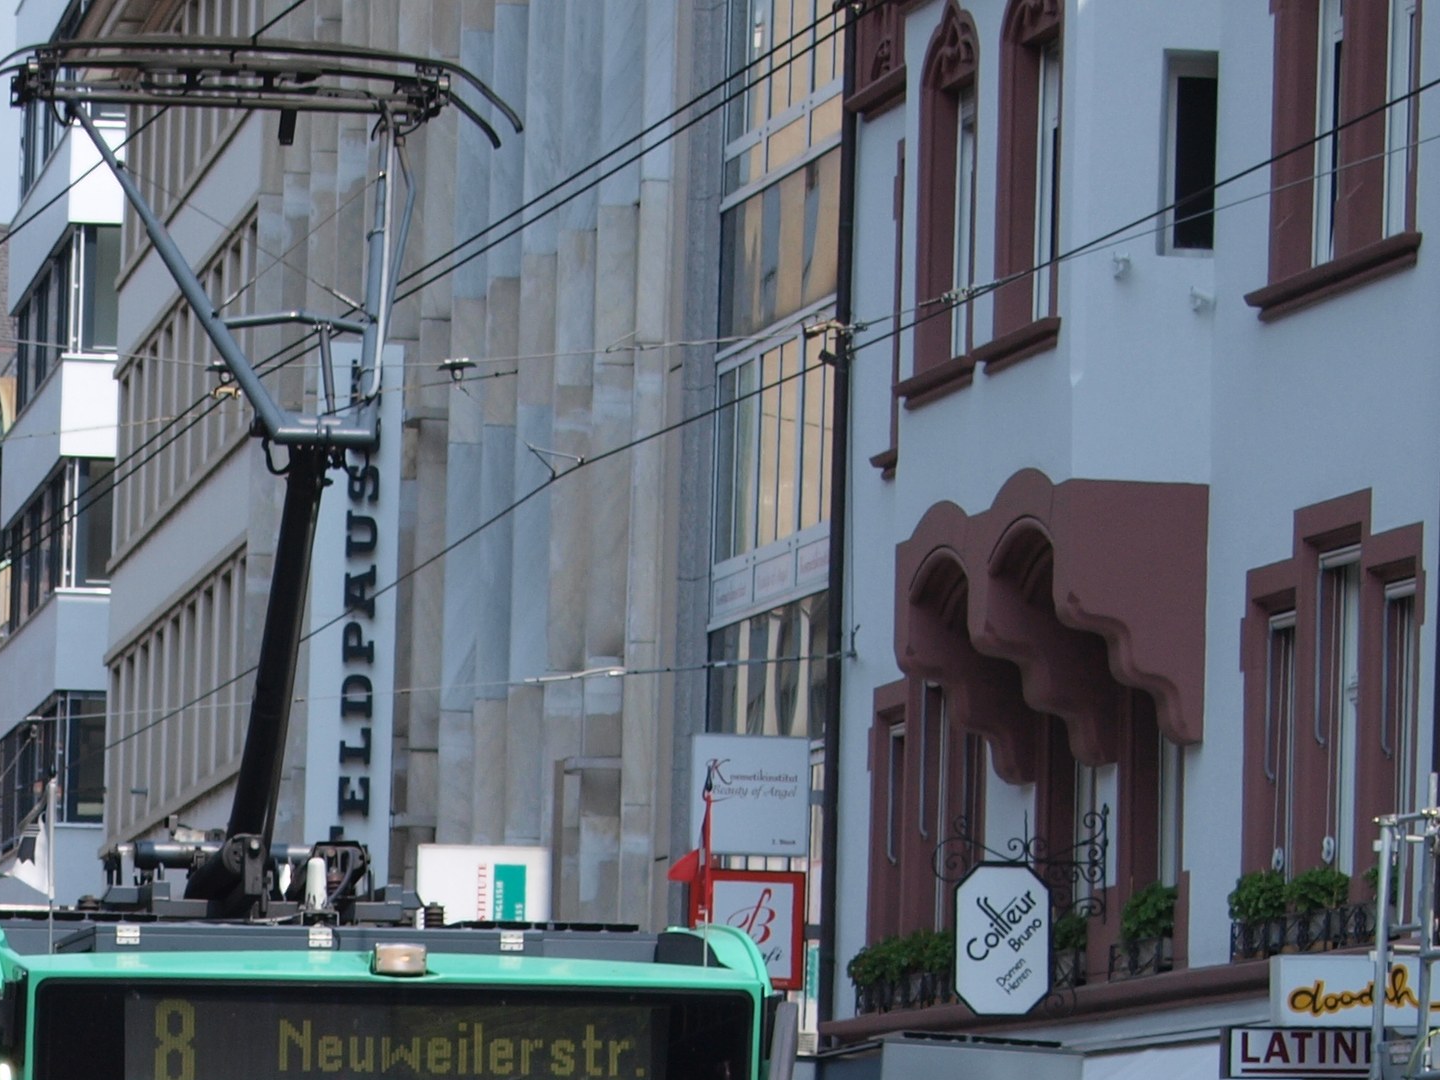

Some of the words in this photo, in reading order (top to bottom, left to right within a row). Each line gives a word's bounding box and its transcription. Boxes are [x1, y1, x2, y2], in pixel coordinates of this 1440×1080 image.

[330, 359, 382, 866] ELDPAUS
[966, 890, 1037, 962] Coiffeur
[1008, 918, 1042, 953] Bruno
[996, 958, 1026, 988] Damen
[278, 1018, 646, 1080] Neuweilerstr.
